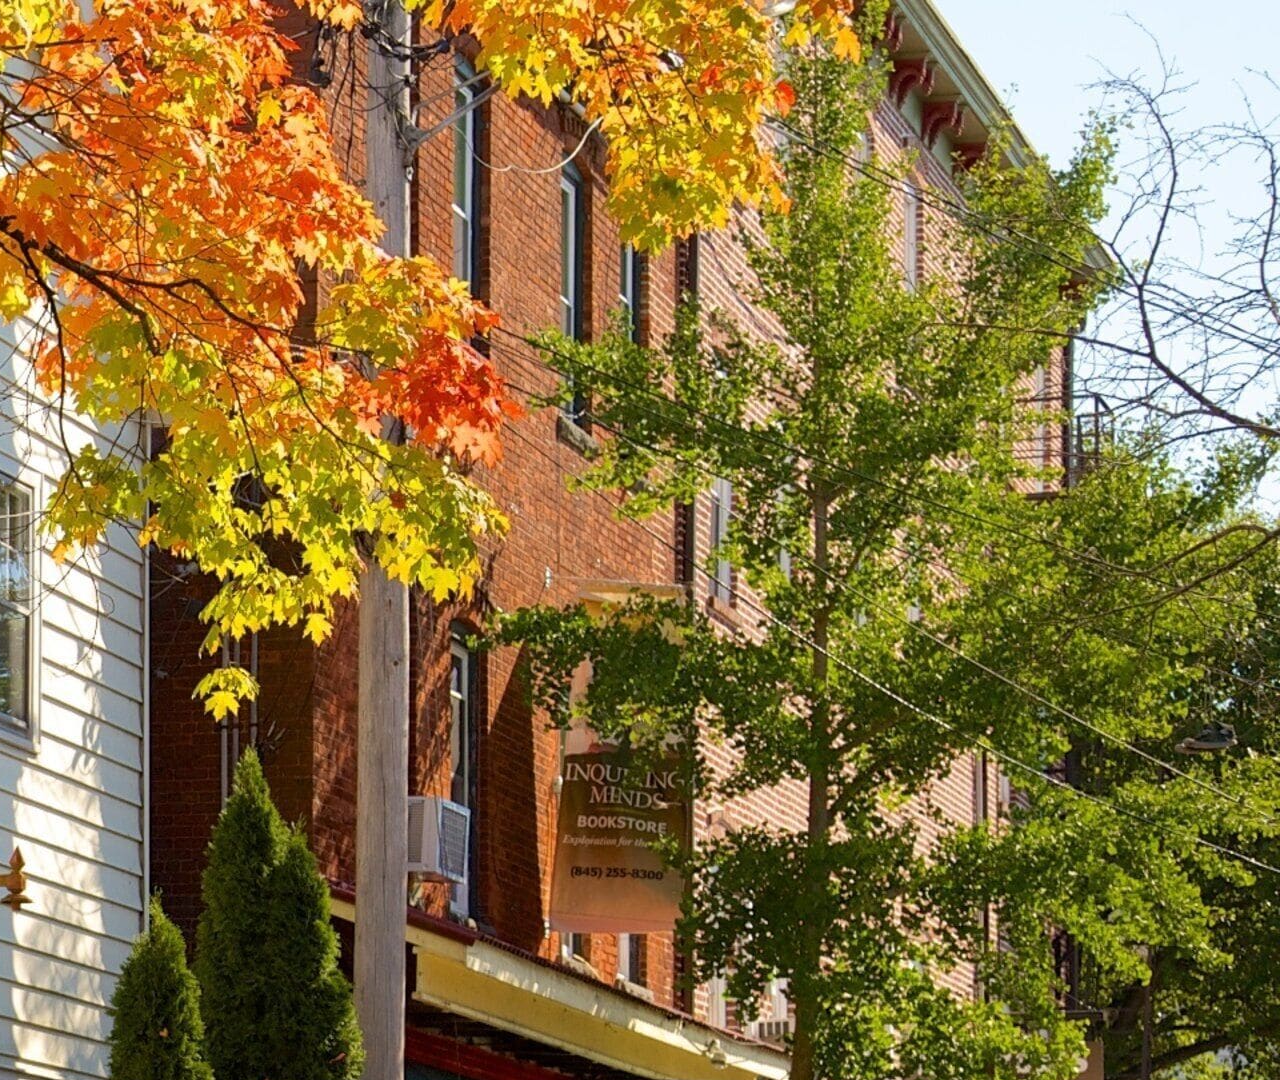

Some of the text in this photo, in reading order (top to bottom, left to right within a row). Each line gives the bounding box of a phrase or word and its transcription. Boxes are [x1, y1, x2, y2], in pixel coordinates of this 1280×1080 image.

[565, 763, 684, 789] INQUING
[590, 786, 666, 810] MINDS
[577, 814, 668, 834] BOOKSTORE
[563, 834, 616, 847] Exploration
[617, 835, 633, 848] for
[570, 866, 664, 881] (845) 255-8300
